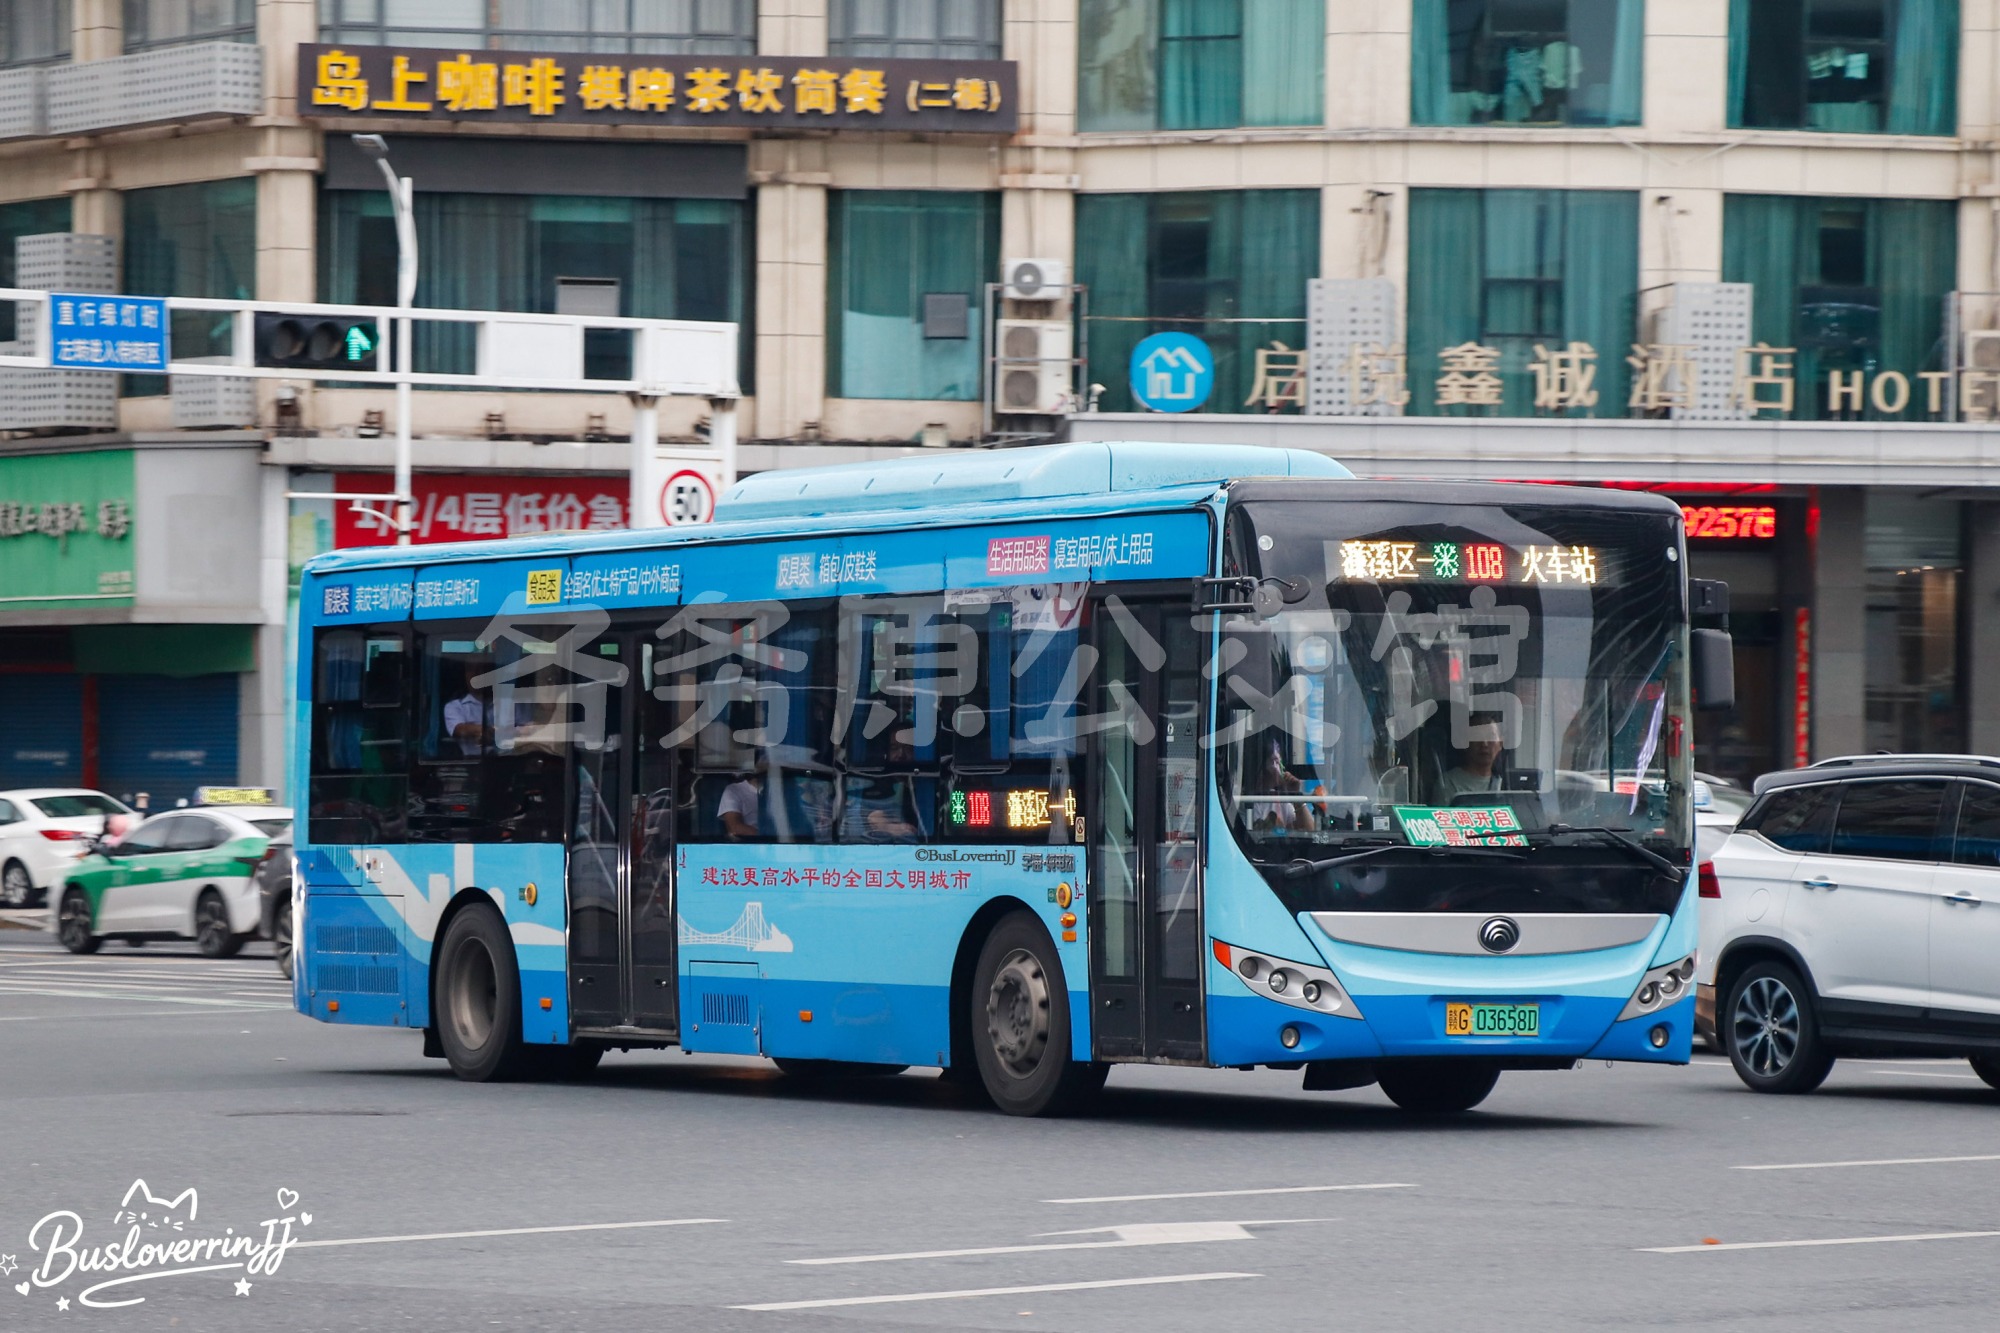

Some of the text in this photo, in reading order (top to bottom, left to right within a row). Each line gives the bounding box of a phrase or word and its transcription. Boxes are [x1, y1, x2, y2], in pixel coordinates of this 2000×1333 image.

[312, 51, 566, 115] 岛上咖啡
[1828, 370, 2000, 413] HOTE
[673, 485, 701, 522] 50
[778, 549, 876, 587] 皮具类 箱包/皮鞋类
[989, 532, 1153, 574] 生活用品类 寝室用品/床上用品
[1466, 546, 1503, 579] 108
[1522, 545, 1596, 583] 火车站
[324, 586, 350, 615] 服装类
[530, 564, 680, 601] 食品类 全国名优土特产品/中外商品
[968, 793, 990, 824] 108
[1433, 810, 1513, 828] 空调开启
[701, 867, 972, 890] 建设更高水平的全国文明城市
[1476, 1009, 1538, 1031] 03658D
